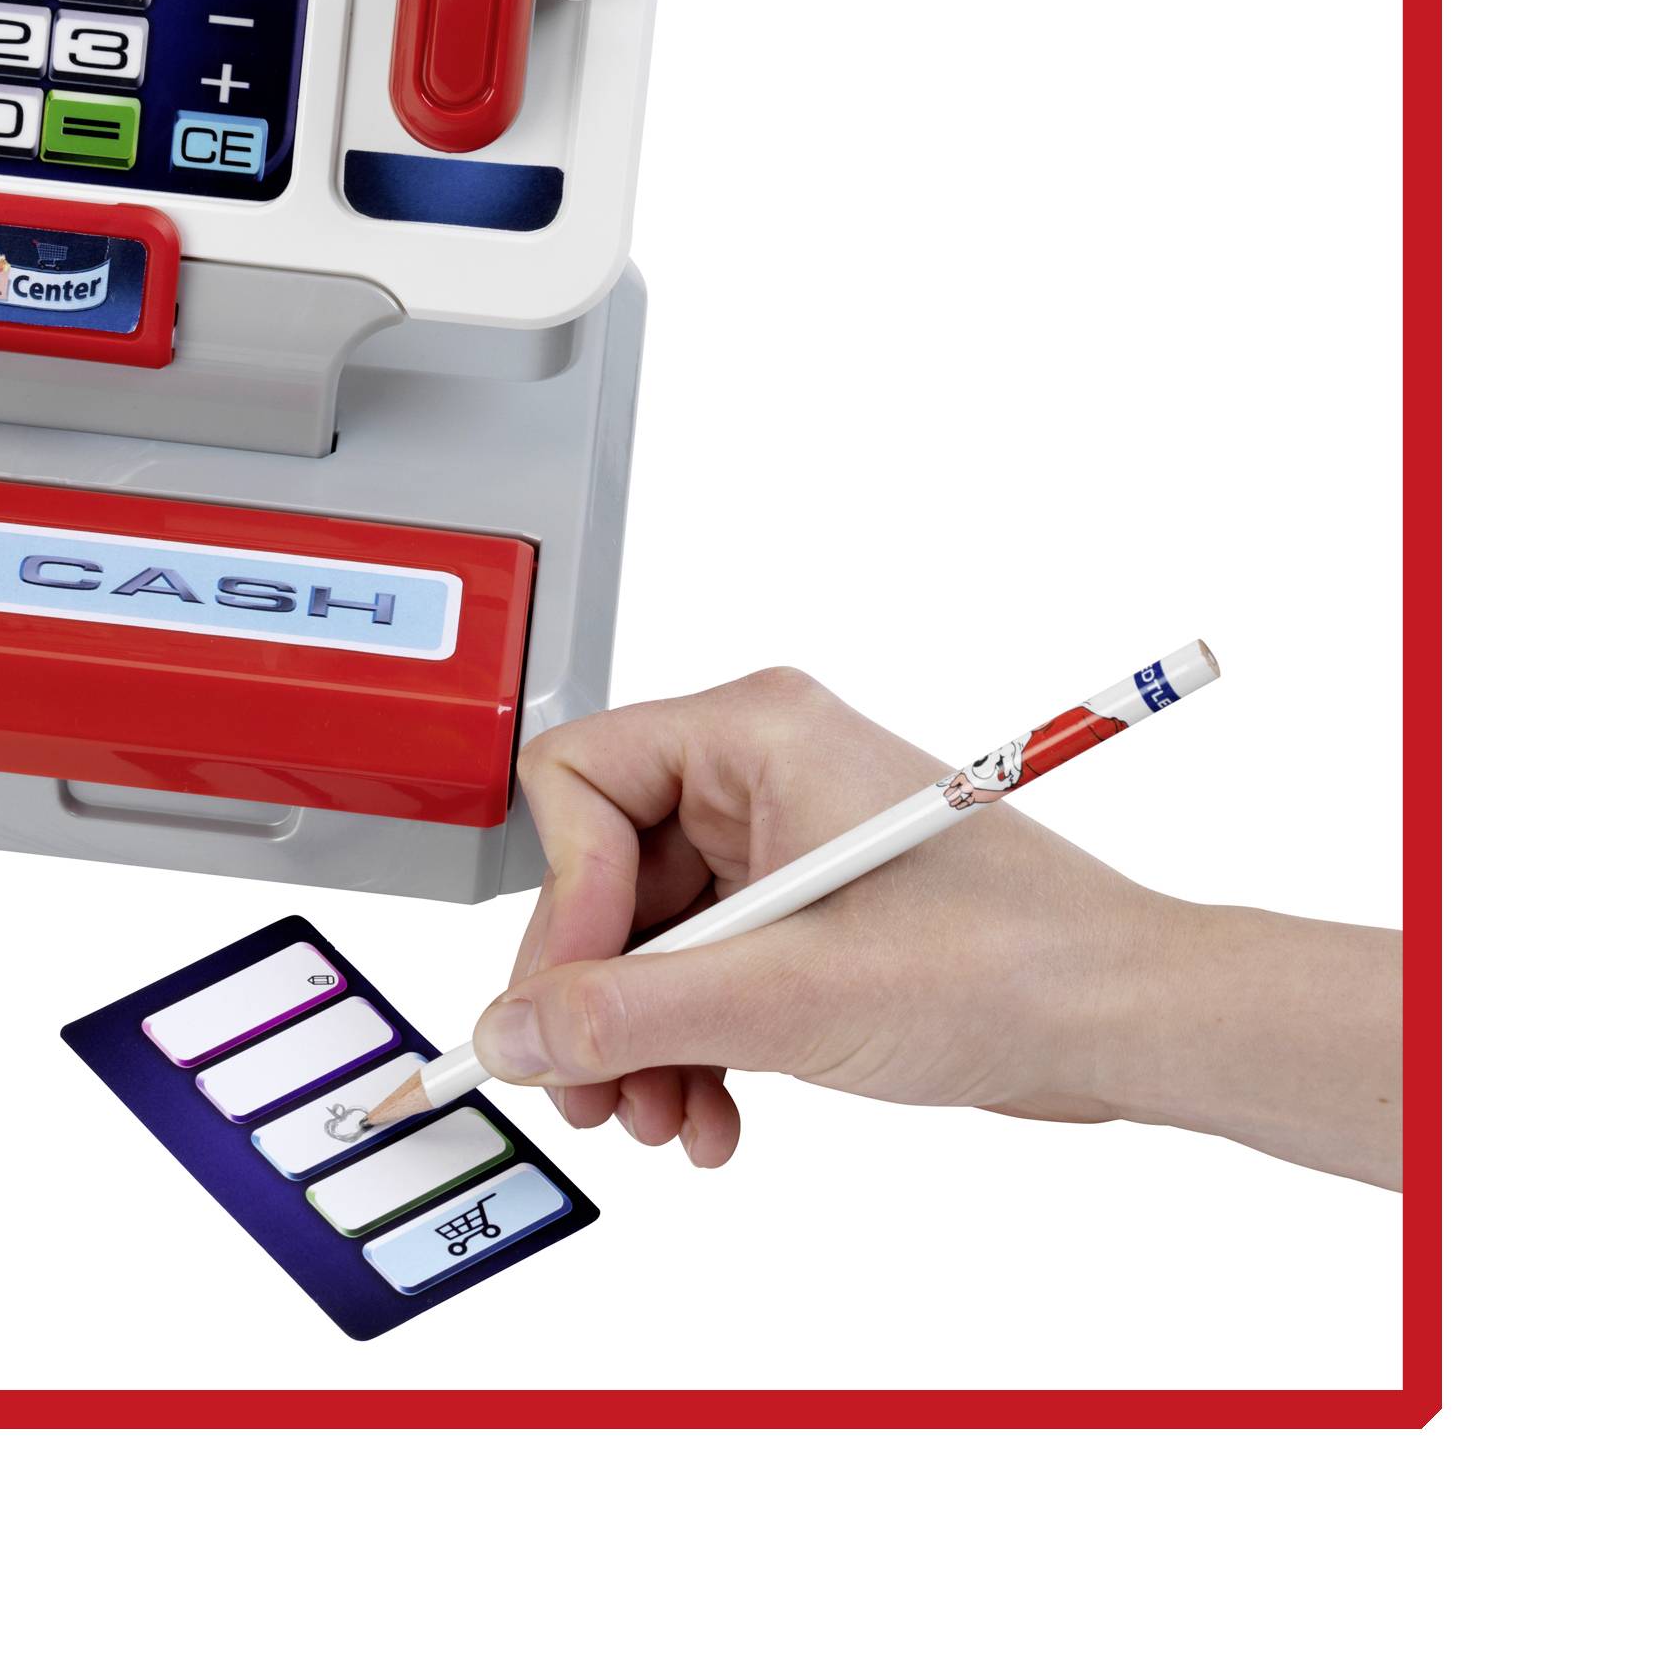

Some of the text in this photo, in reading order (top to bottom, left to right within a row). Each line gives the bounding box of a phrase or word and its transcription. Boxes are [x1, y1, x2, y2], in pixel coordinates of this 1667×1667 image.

[68, 28, 129, 70] 3
[180, 126, 255, 168] CE
[12, 274, 102, 302] Center
[18, 554, 397, 626] CASH
